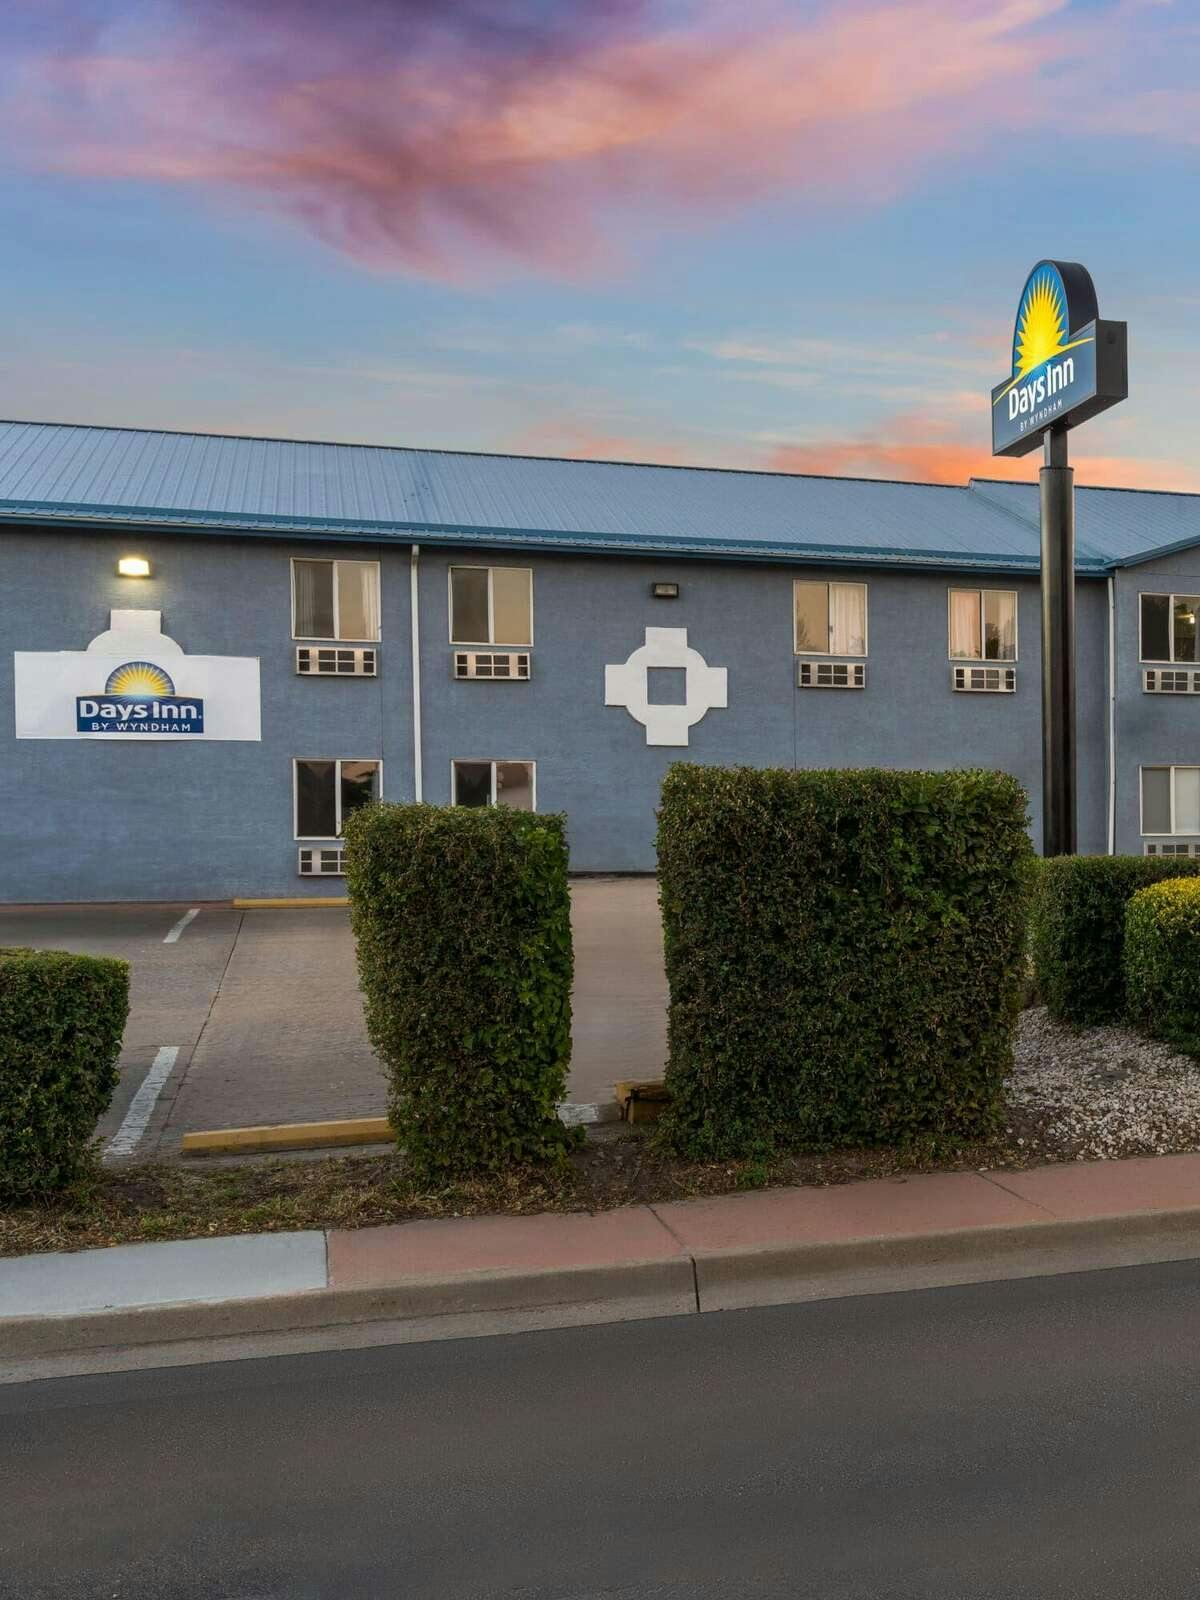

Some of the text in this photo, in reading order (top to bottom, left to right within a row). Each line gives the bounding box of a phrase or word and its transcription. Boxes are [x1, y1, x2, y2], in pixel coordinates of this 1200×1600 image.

[1008, 357, 1074, 421] Days Inn
[1020, 399, 1063, 432] BY WYNDHAM
[79, 700, 149, 721] Days
[92, 722, 191, 732] BY WYNDHAM
